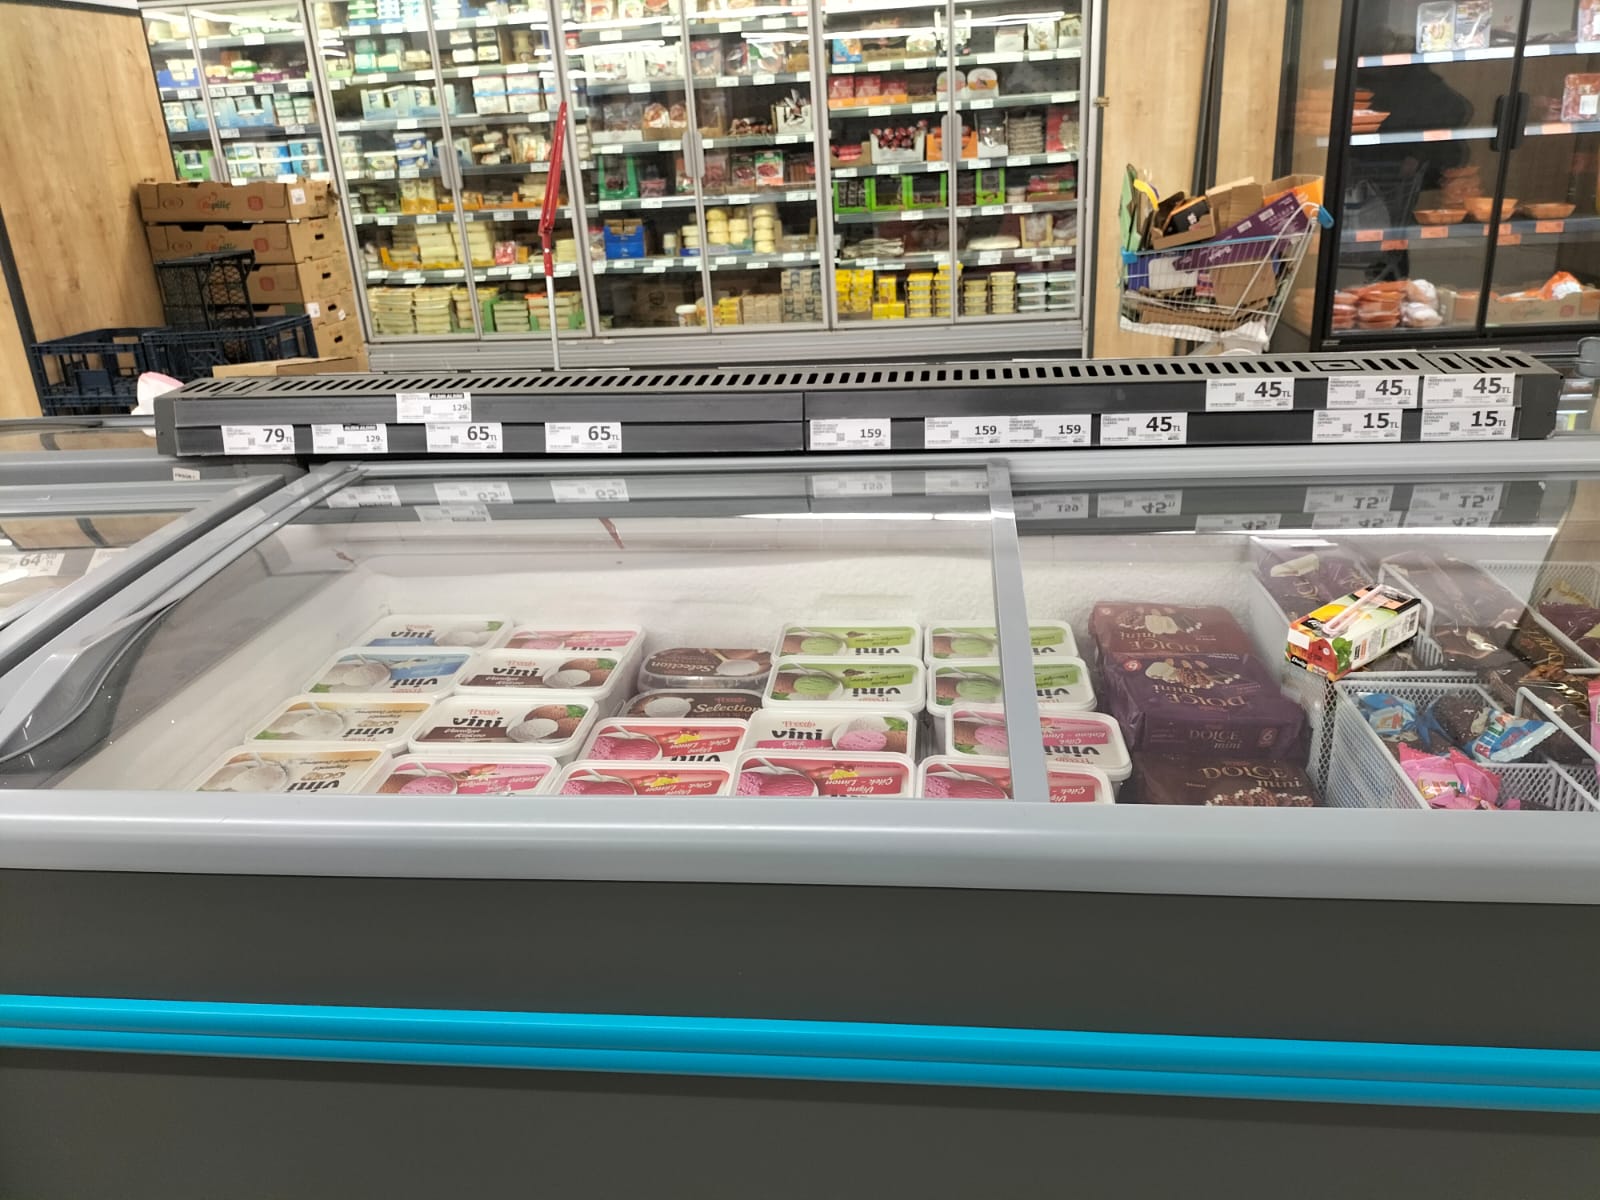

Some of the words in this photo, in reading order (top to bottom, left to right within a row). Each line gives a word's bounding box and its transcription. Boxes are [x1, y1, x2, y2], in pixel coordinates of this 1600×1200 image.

[1254, 382, 1282, 398] 45
[1376, 380, 1403, 395] 45
[1473, 378, 1502, 394] 45
[1146, 417, 1172, 432] 45
[1363, 413, 1390, 429] 15
[1471, 411, 1499, 427] 15
[262, 428, 284, 443] 79
[467, 426, 489, 441] 65
[588, 426, 611, 441] 65
[860, 429, 882, 438] 159
[975, 426, 997, 435] 159
[1058, 425, 1081, 435] 159
[453, 716, 504, 727] vini
[771, 728, 823, 740] vini
[1045, 746, 1100, 757] vini
[1200, 766, 1287, 780] DOLCE
